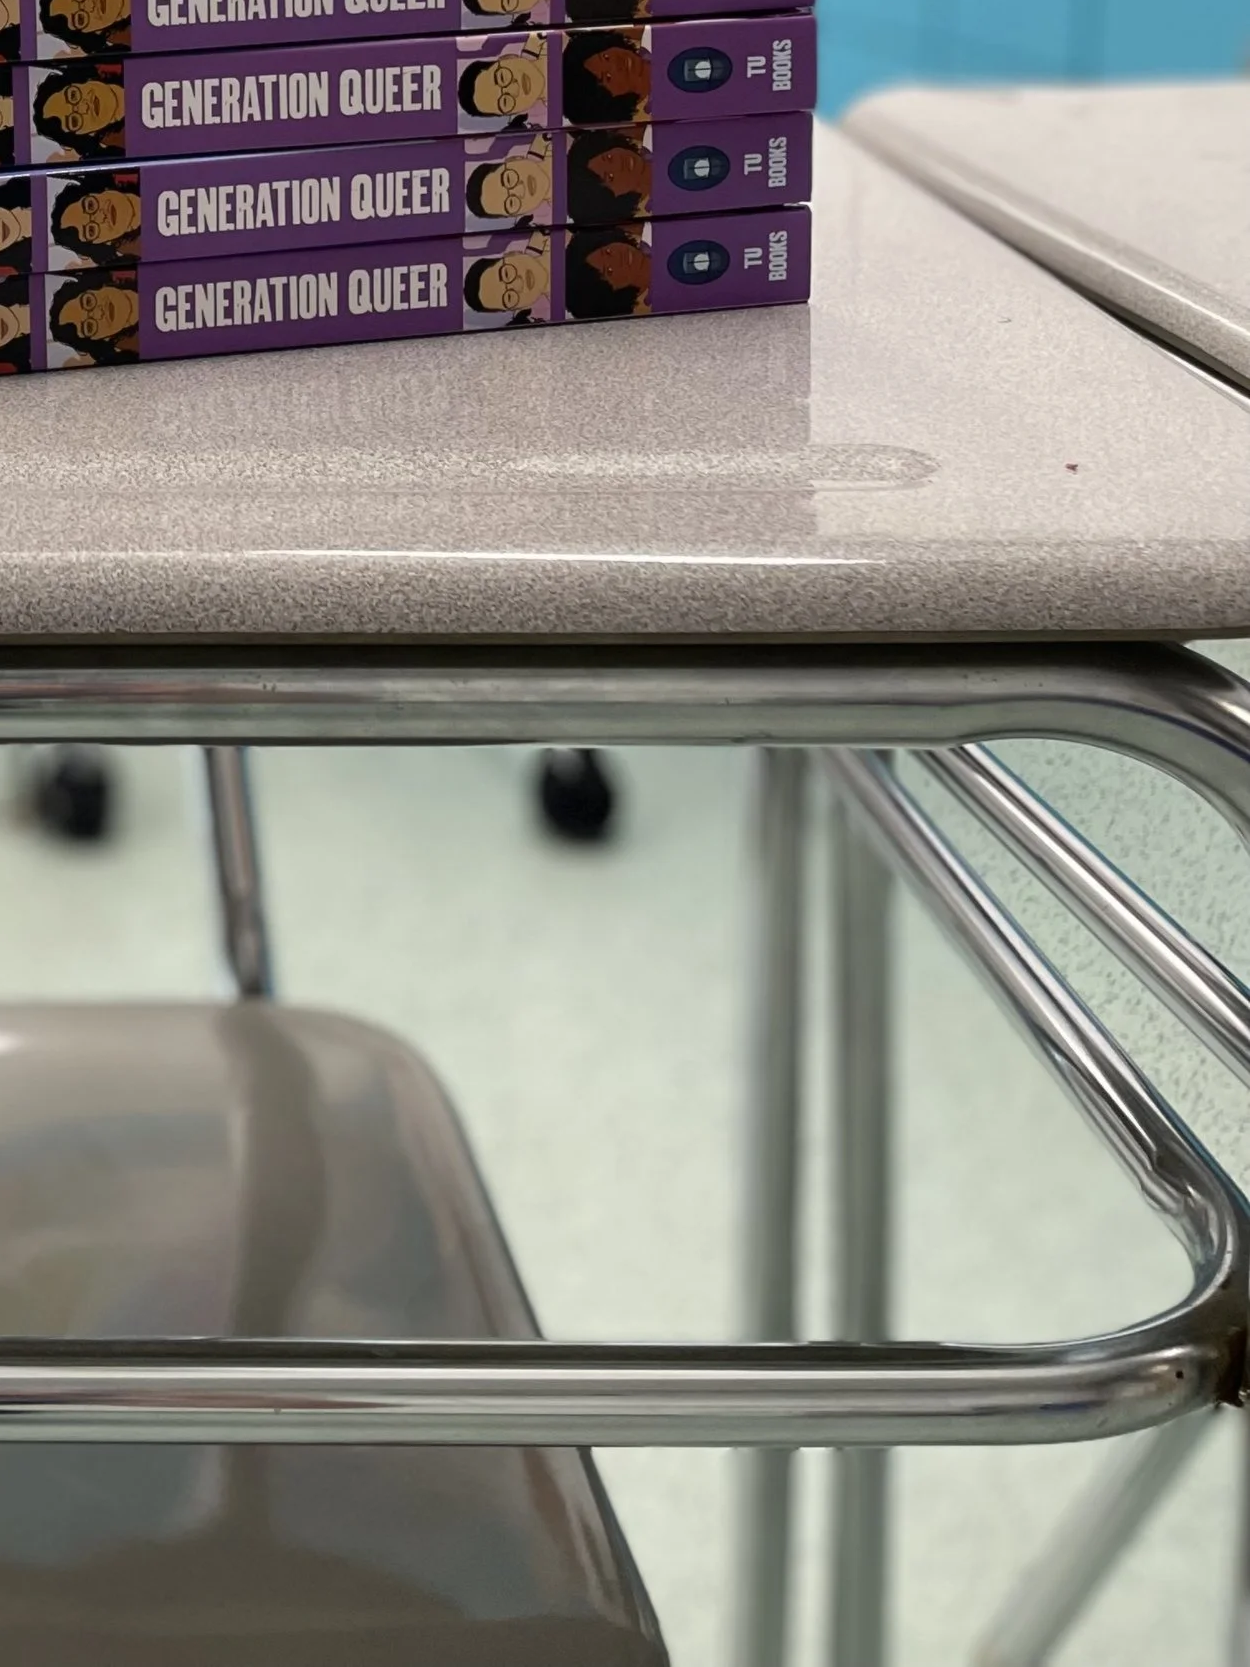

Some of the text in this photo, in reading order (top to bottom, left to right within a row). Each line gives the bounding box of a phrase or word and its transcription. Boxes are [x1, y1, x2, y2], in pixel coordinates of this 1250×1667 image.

[747, 56, 766, 77] TU
[772, 39, 792, 92] BOOKS
[142, 65, 442, 129] GENERATION QUEER
[744, 153, 763, 175] TU
[768, 137, 787, 188] BOOKS
[157, 168, 450, 237] GENERATION QUEER
[744, 247, 763, 269] TU
[768, 230, 788, 282] BOOKS
[155, 263, 448, 332] GENERATION QUEER
